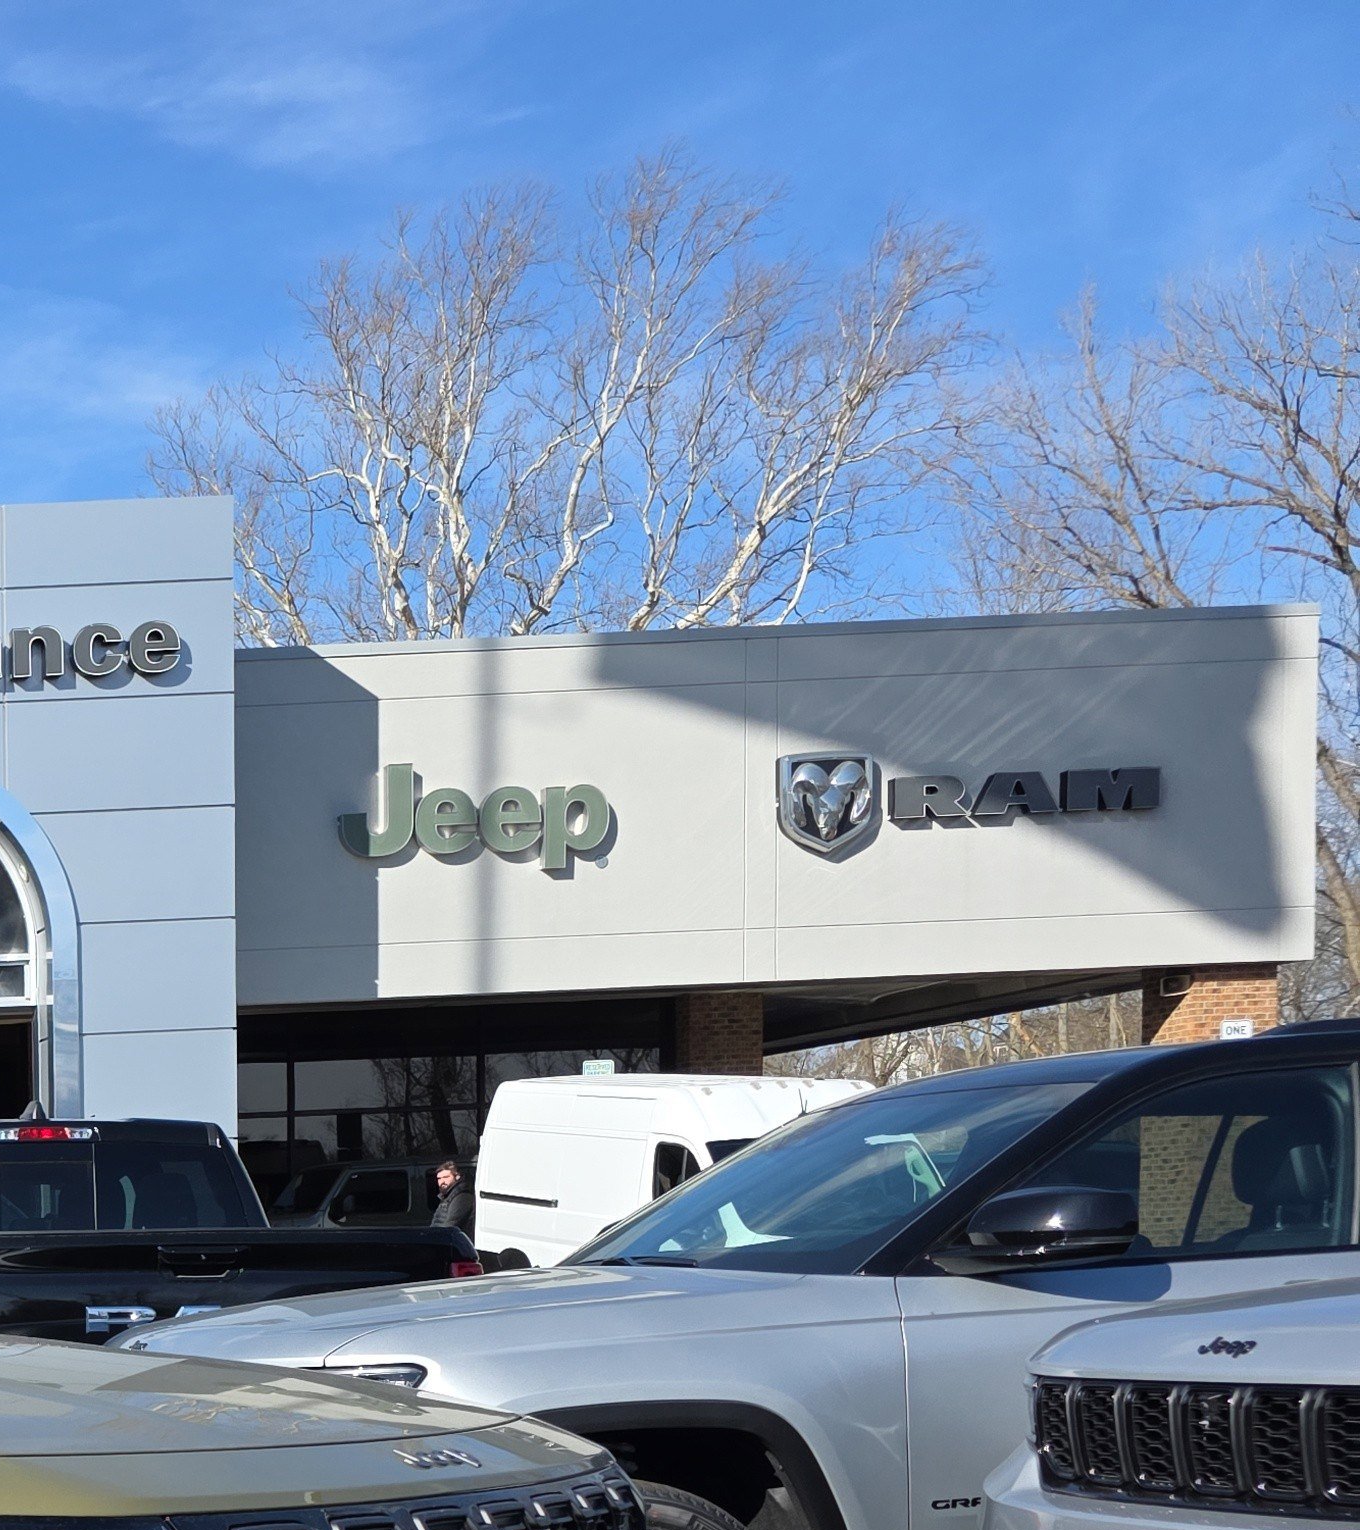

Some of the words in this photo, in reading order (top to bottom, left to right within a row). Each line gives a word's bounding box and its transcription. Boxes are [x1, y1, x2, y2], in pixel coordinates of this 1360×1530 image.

[888, 766, 1161, 820] RAM
[338, 763, 610, 870] Jeep
[1225, 1025, 1247, 1036] ONE
[1197, 1335, 1258, 1359] Jeep
